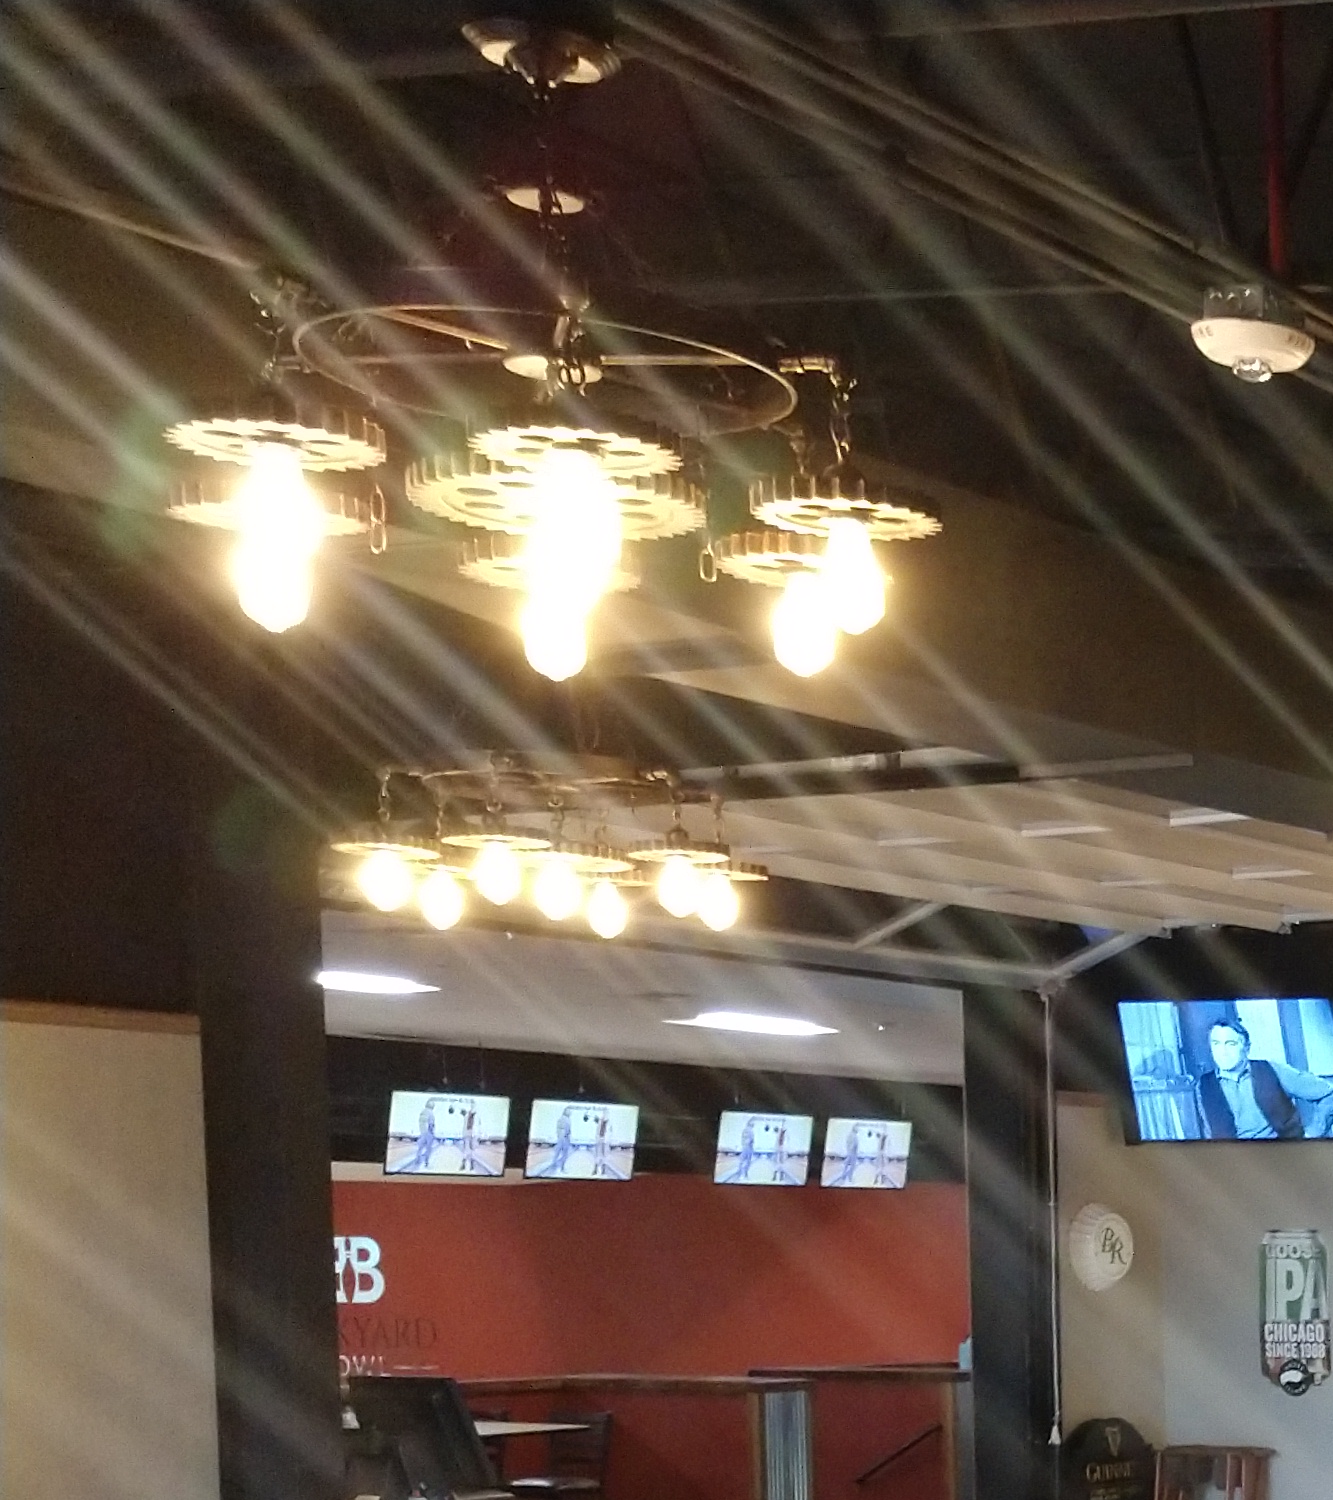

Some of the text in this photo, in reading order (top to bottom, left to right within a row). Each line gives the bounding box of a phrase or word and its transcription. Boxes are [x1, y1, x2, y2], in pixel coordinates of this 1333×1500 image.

[1265, 1258, 1329, 1322] IPA
[1263, 1322, 1326, 1343] CHICAGO
[1264, 1342, 1299, 1359] SINCE
